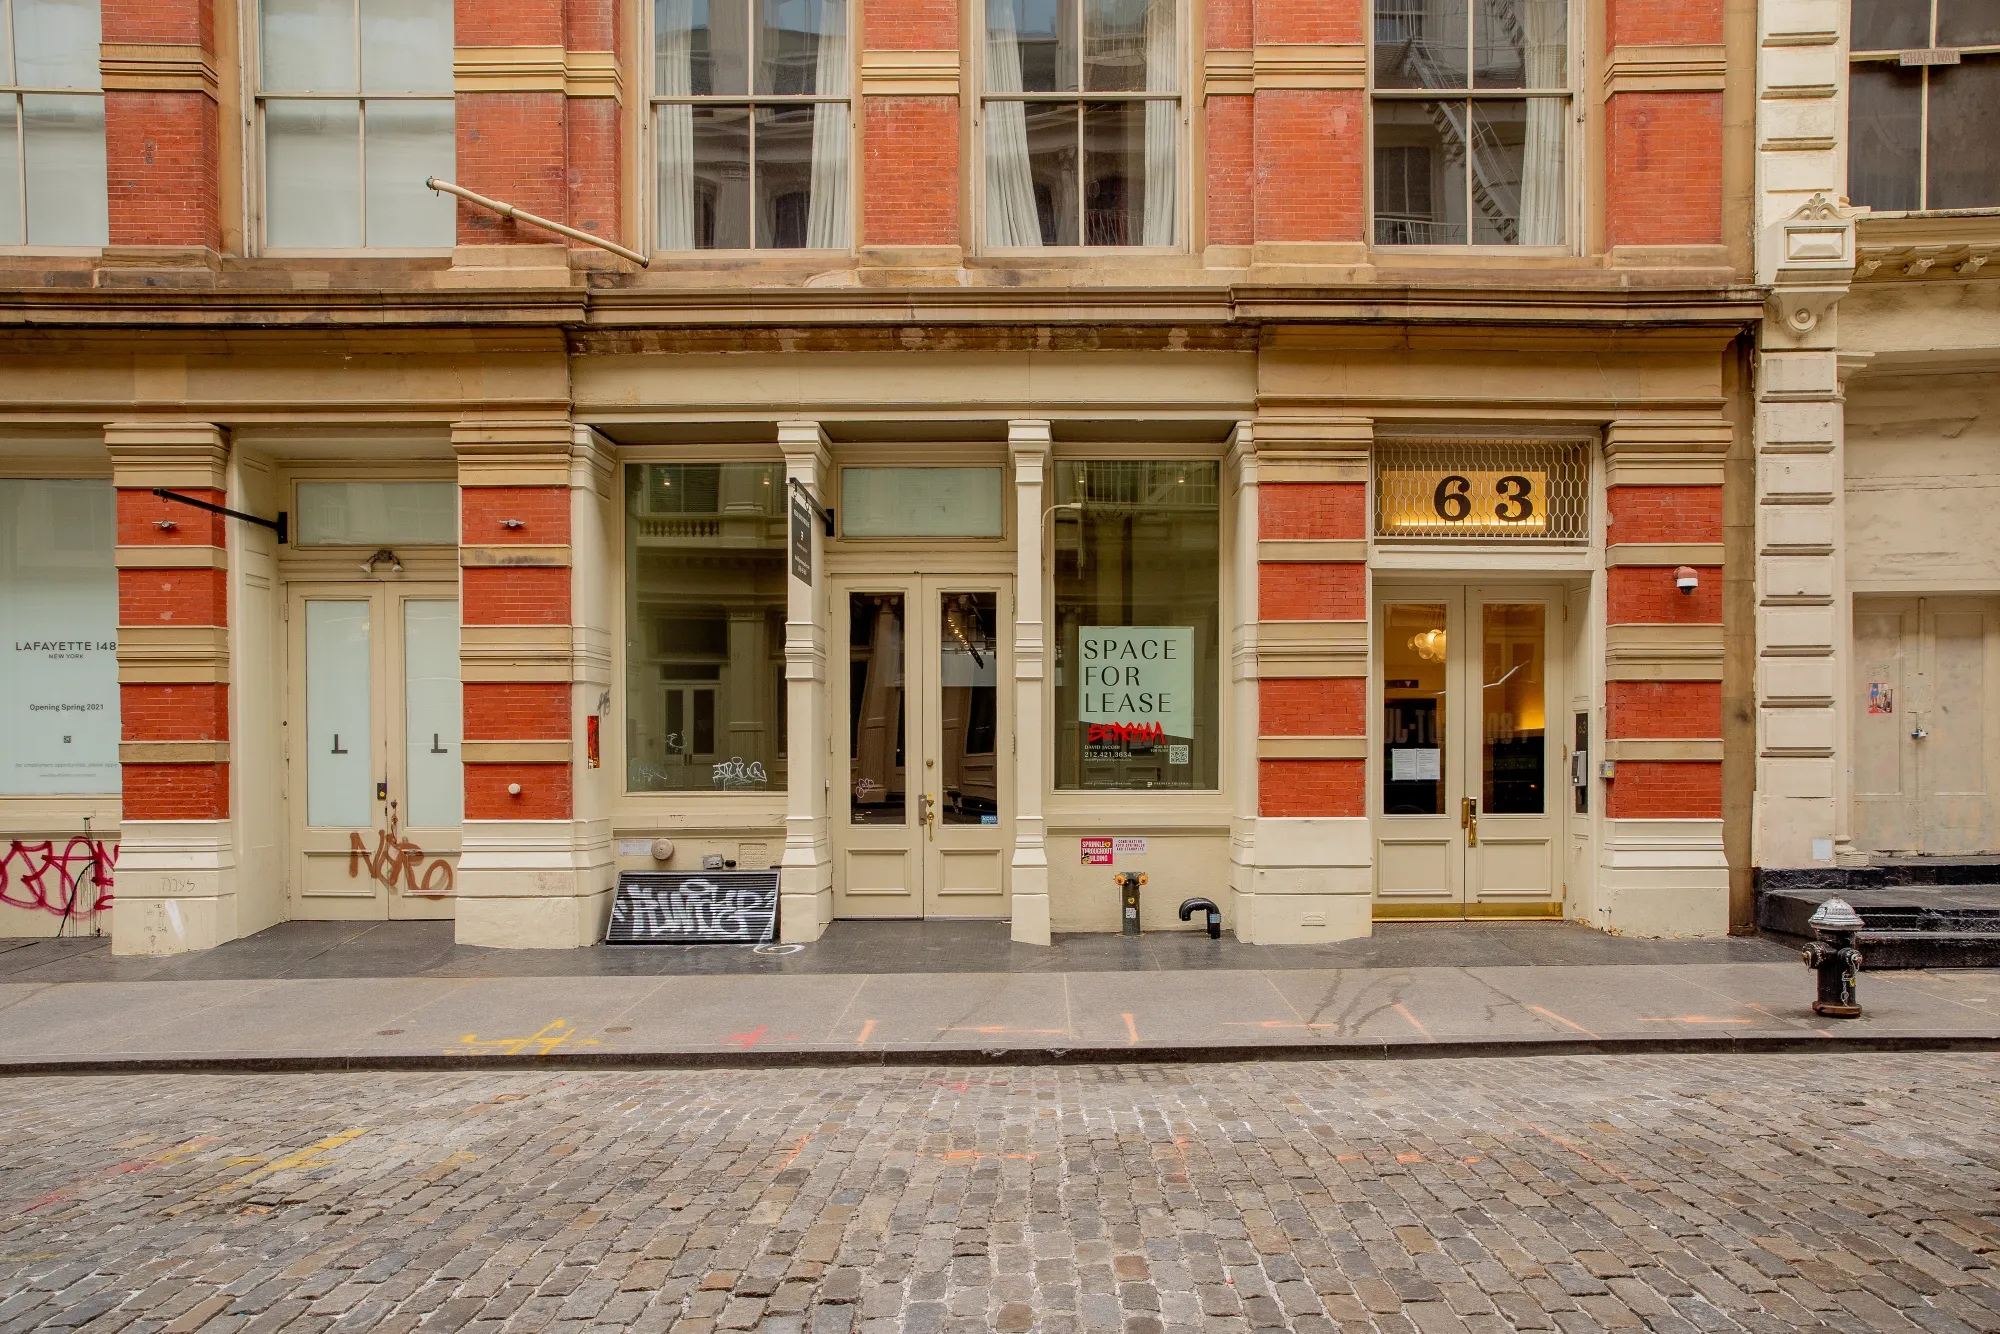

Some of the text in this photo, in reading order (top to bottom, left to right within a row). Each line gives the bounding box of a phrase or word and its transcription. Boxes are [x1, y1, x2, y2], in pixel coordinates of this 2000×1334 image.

[1903, 50, 1955, 64] SHAFTWAY
[1434, 475, 1534, 522] 63
[15, 641, 117, 651] LAFAYETTE 148
[1083, 639, 1178, 660] SPACE
[1085, 665, 1140, 686] FOR
[29, 703, 104, 713] Opening Spring 2021
[1085, 692, 1172, 713] LEASE
[1082, 848, 1112, 856] THROUGHOUT
